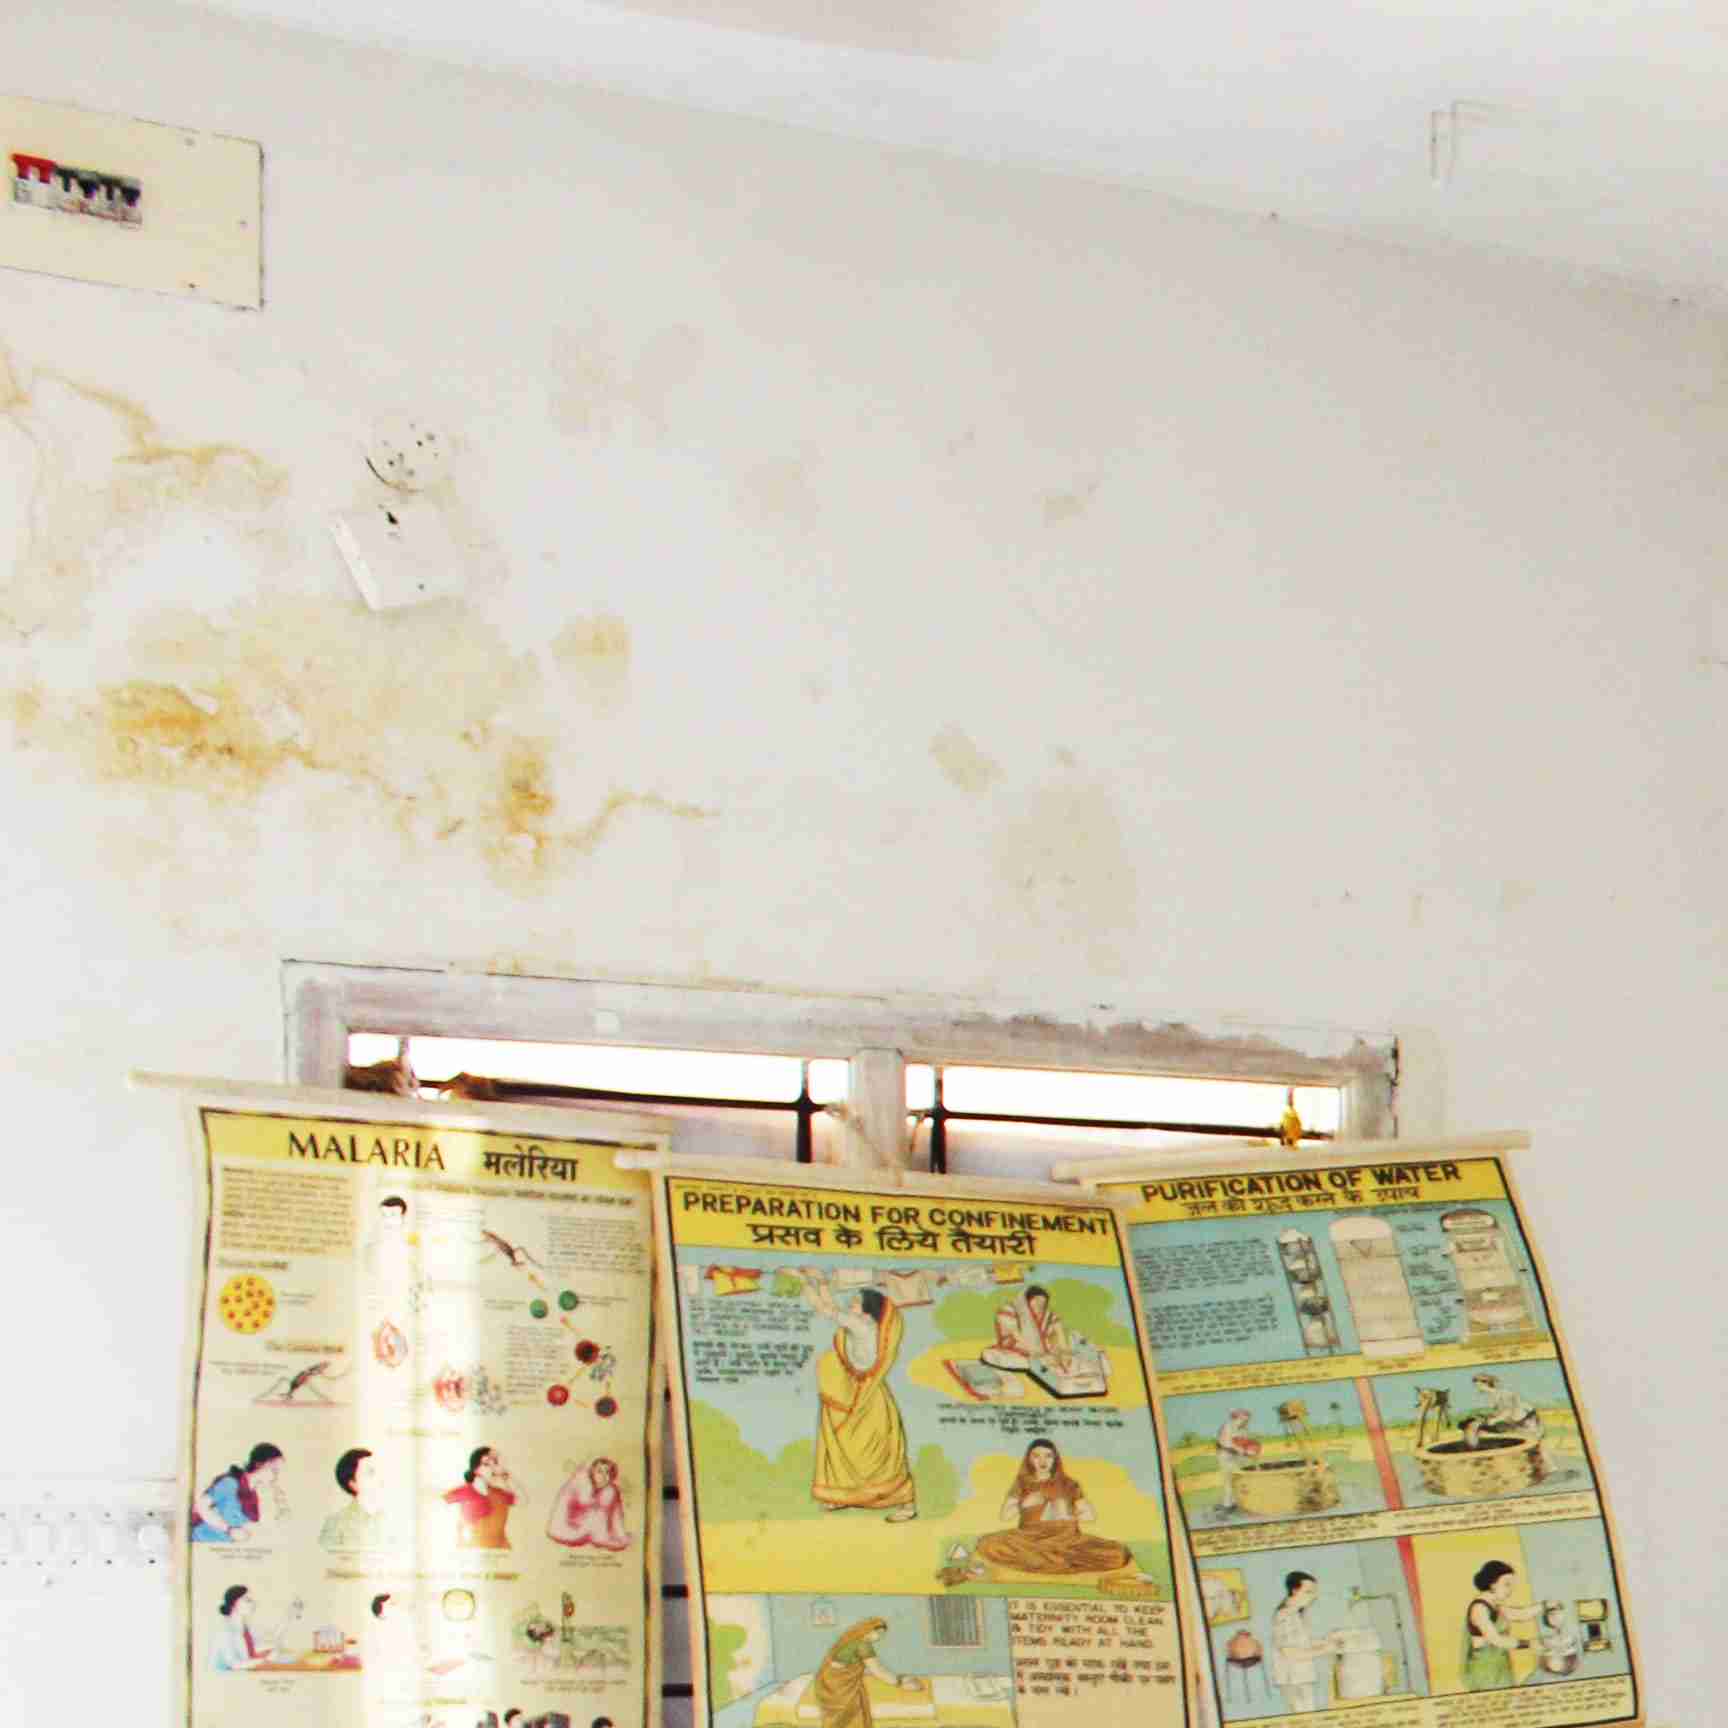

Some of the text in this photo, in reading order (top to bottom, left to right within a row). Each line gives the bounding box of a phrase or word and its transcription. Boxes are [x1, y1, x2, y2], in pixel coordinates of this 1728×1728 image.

[288, 1130, 447, 1171] MALARIA
[482, 1144, 579, 1182] मलेरिया
[1141, 1162, 1463, 1203] PURIFICATION OF WATER
[683, 1190, 1110, 1236] PREPARATION FOR CONFINEMENT
[745, 1222, 1037, 1257] प्रसव के लिये तैयारी
